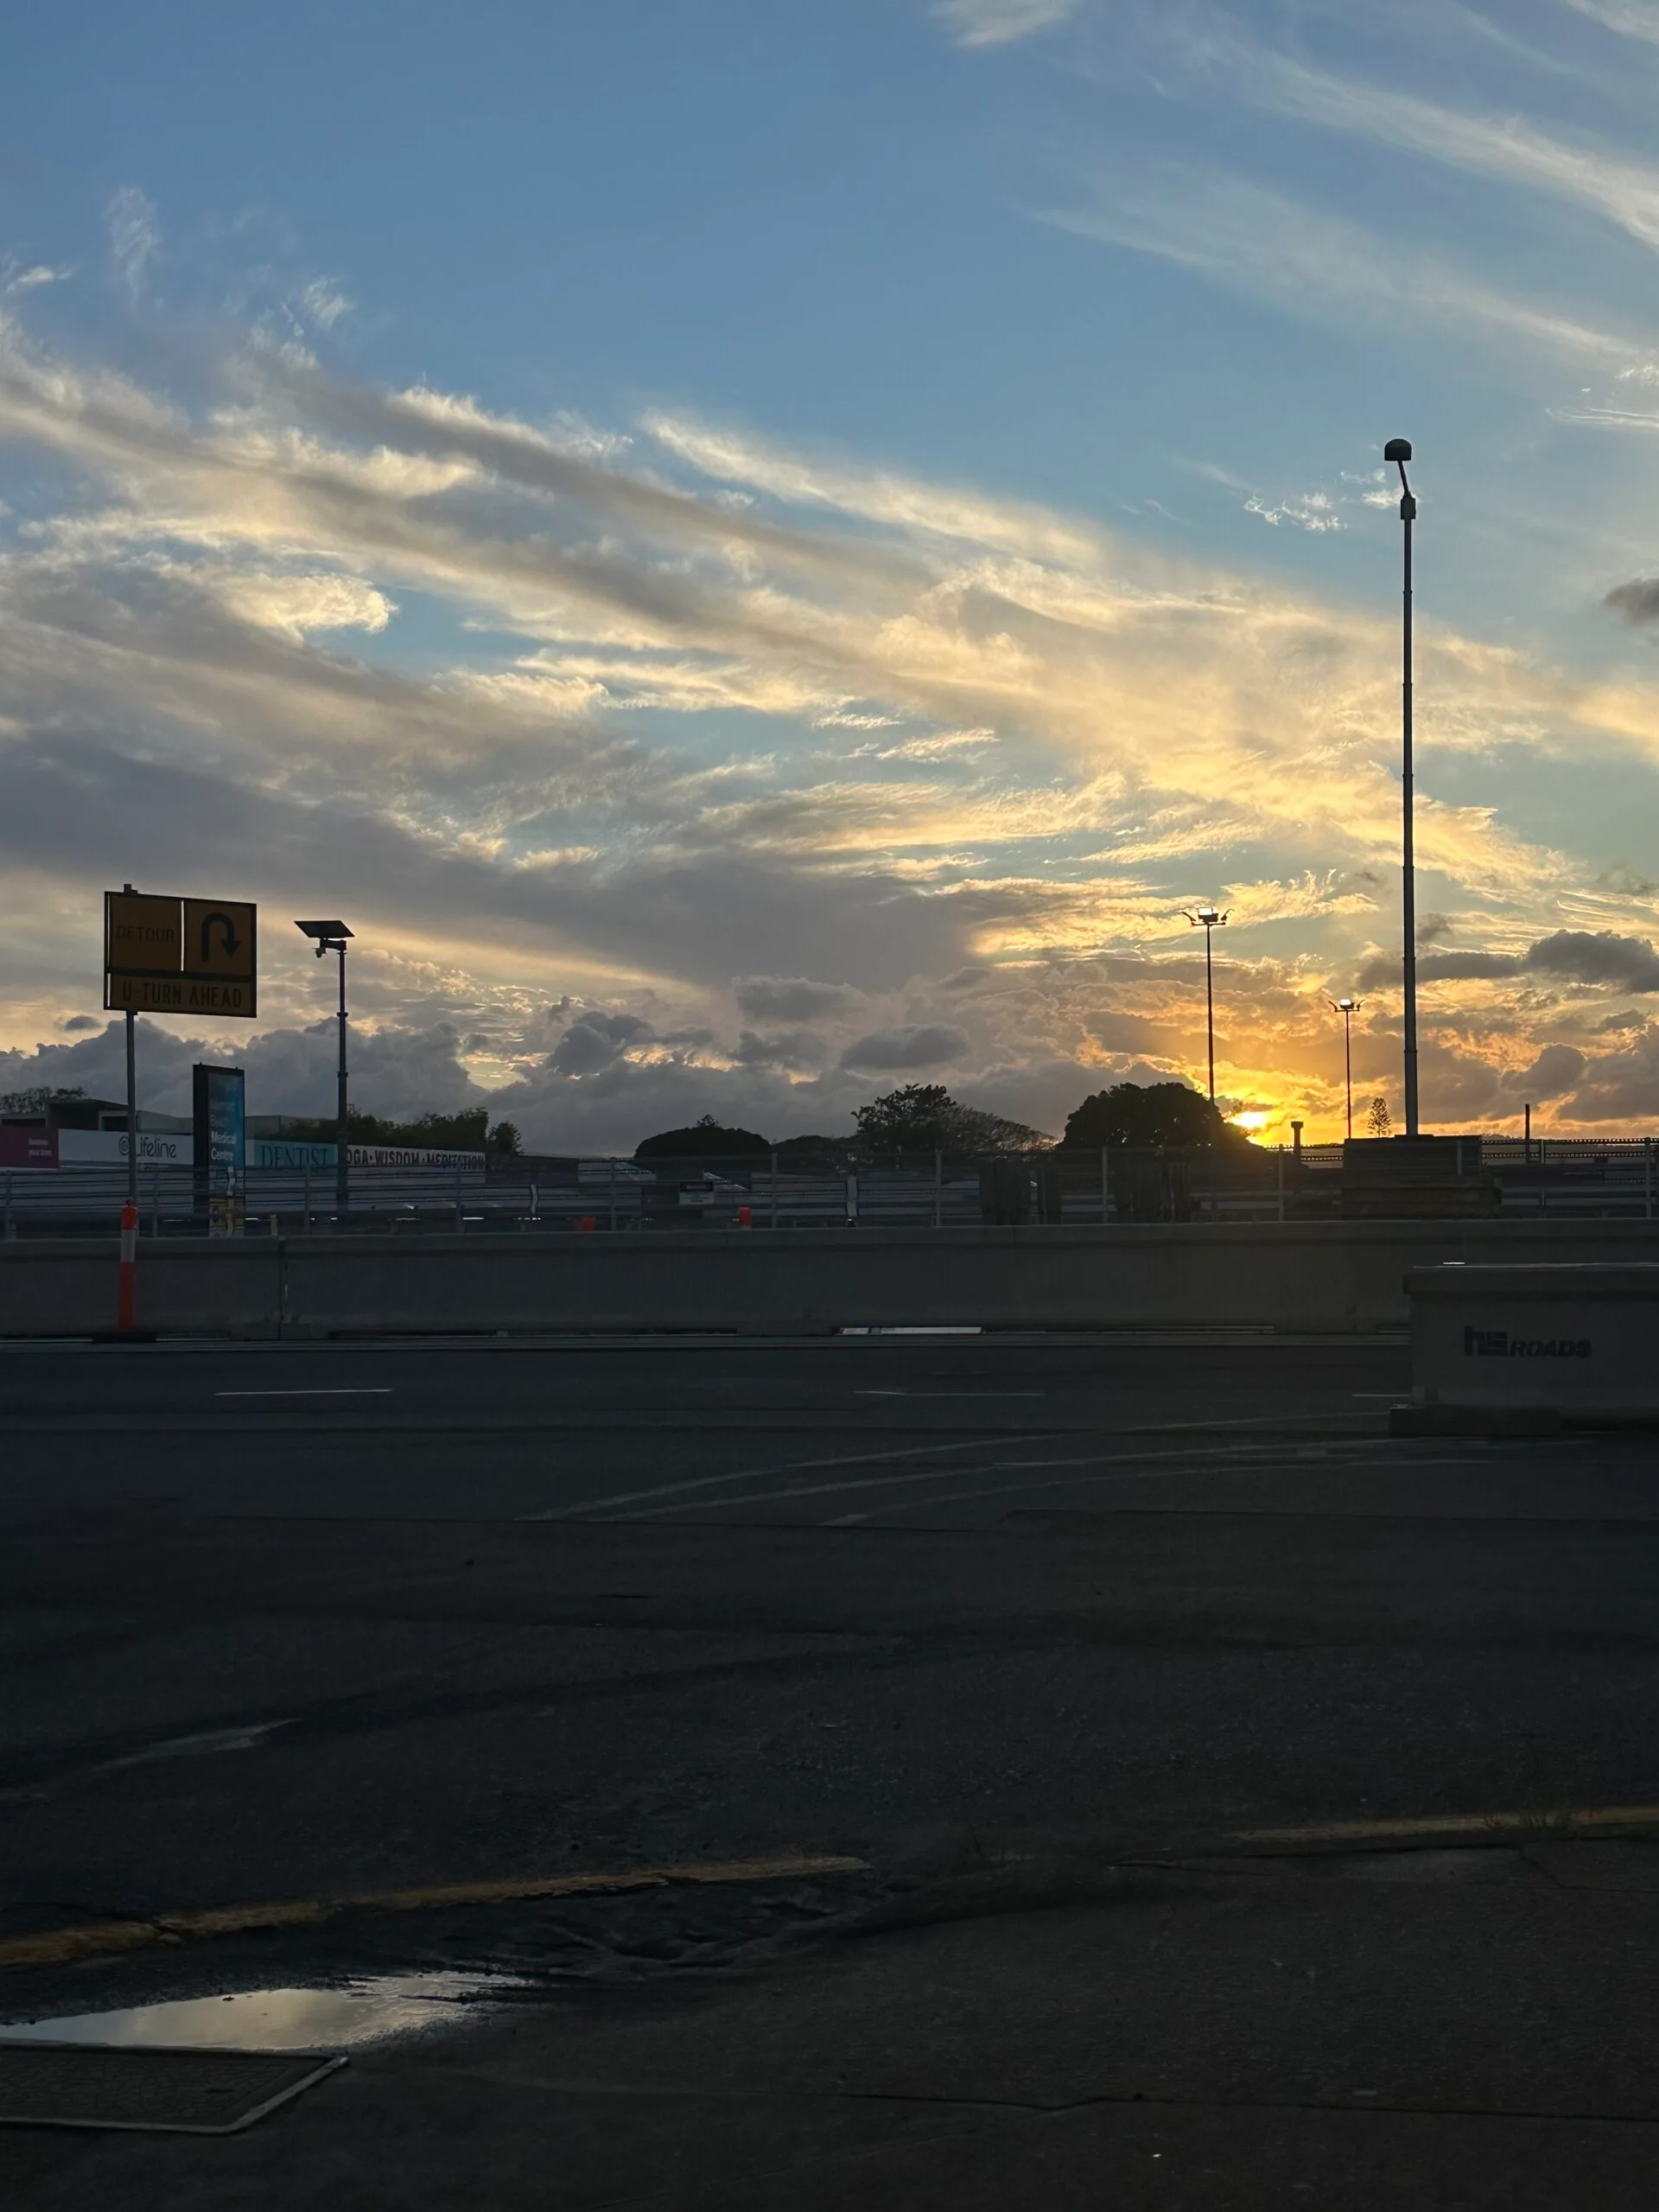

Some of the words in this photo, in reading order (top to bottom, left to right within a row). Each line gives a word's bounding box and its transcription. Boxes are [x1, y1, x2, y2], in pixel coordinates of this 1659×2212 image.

[117, 925, 175, 943] DETOUR
[123, 982, 181, 1004] U-TURN
[189, 985, 242, 1007] AHEAD
[211, 1131, 236, 1144] Medical
[262, 1145, 328, 1168] DENTIST
[346, 1149, 368, 1165] OGA
[375, 1150, 419, 1166] WISDOM
[427, 1154, 484, 1170] MEDITATION
[1509, 1339, 1592, 1358] ROADS
